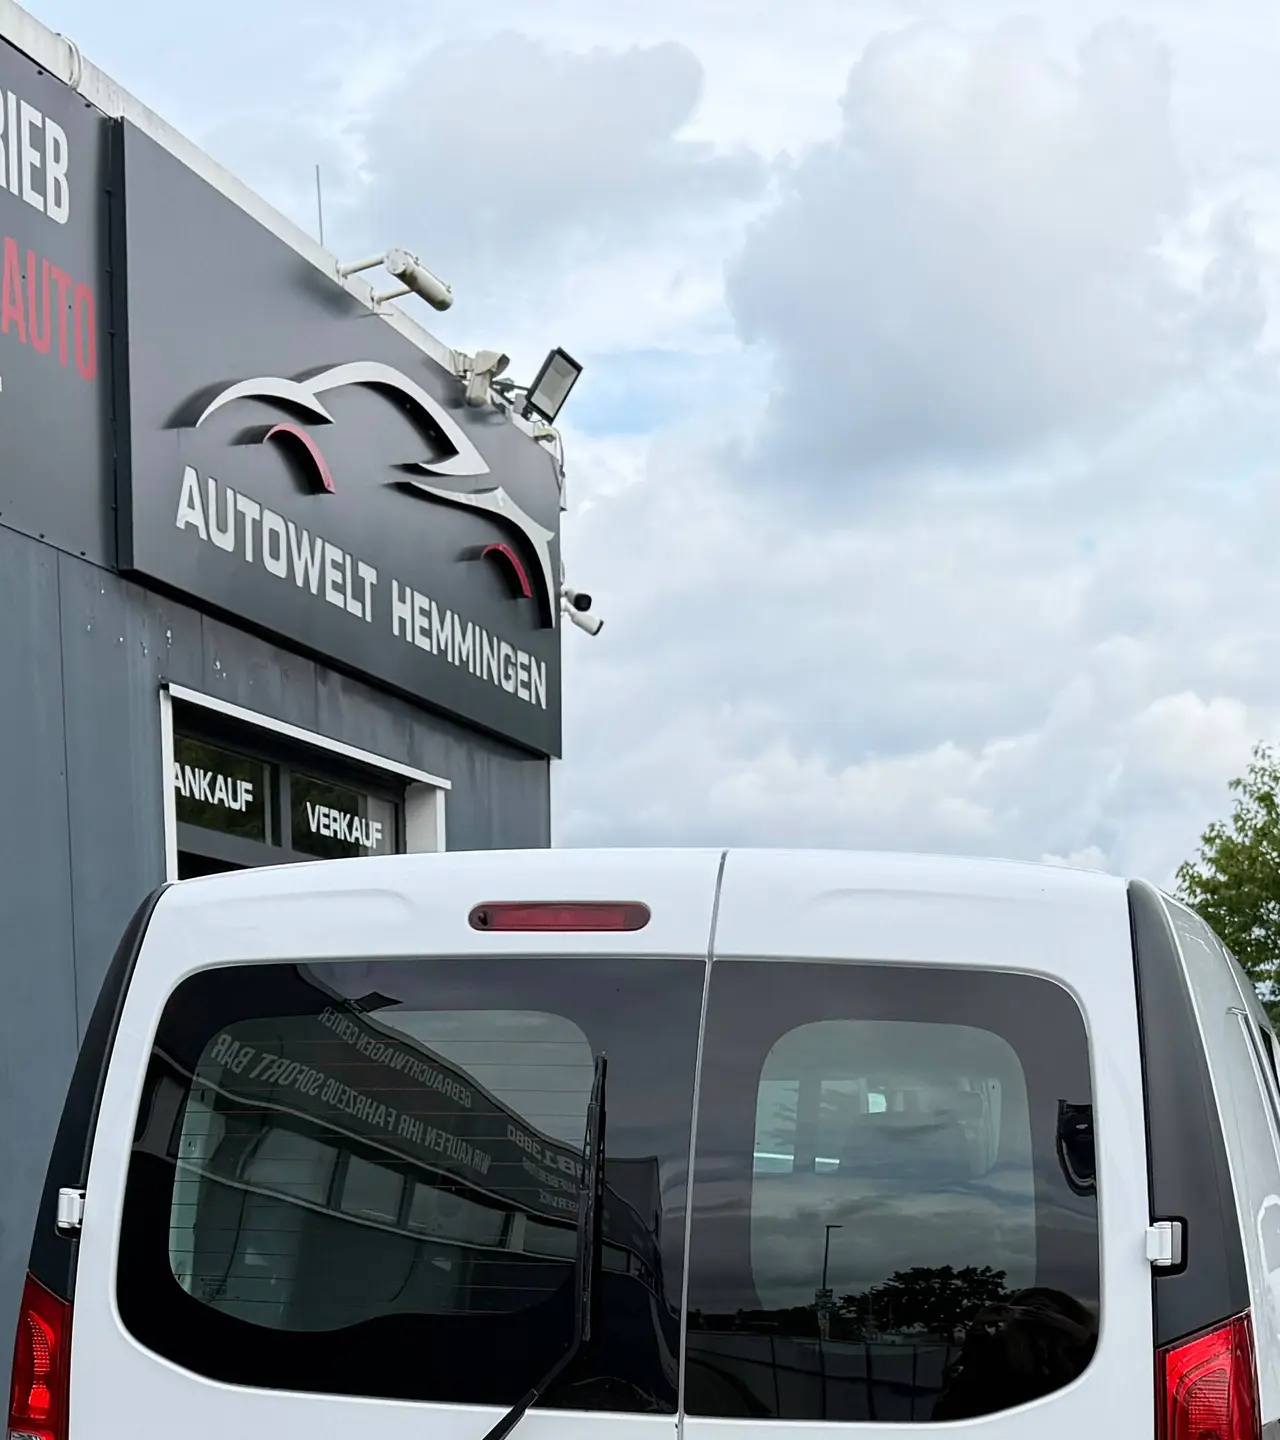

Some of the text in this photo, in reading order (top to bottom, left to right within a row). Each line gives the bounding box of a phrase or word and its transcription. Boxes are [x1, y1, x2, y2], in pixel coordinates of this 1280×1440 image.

[1, 237, 97, 381] AUTO
[176, 465, 548, 710] AUTOWELT HEMMINGEN
[172, 762, 253, 812] ANKAUF
[306, 801, 383, 850] VERKAUF
